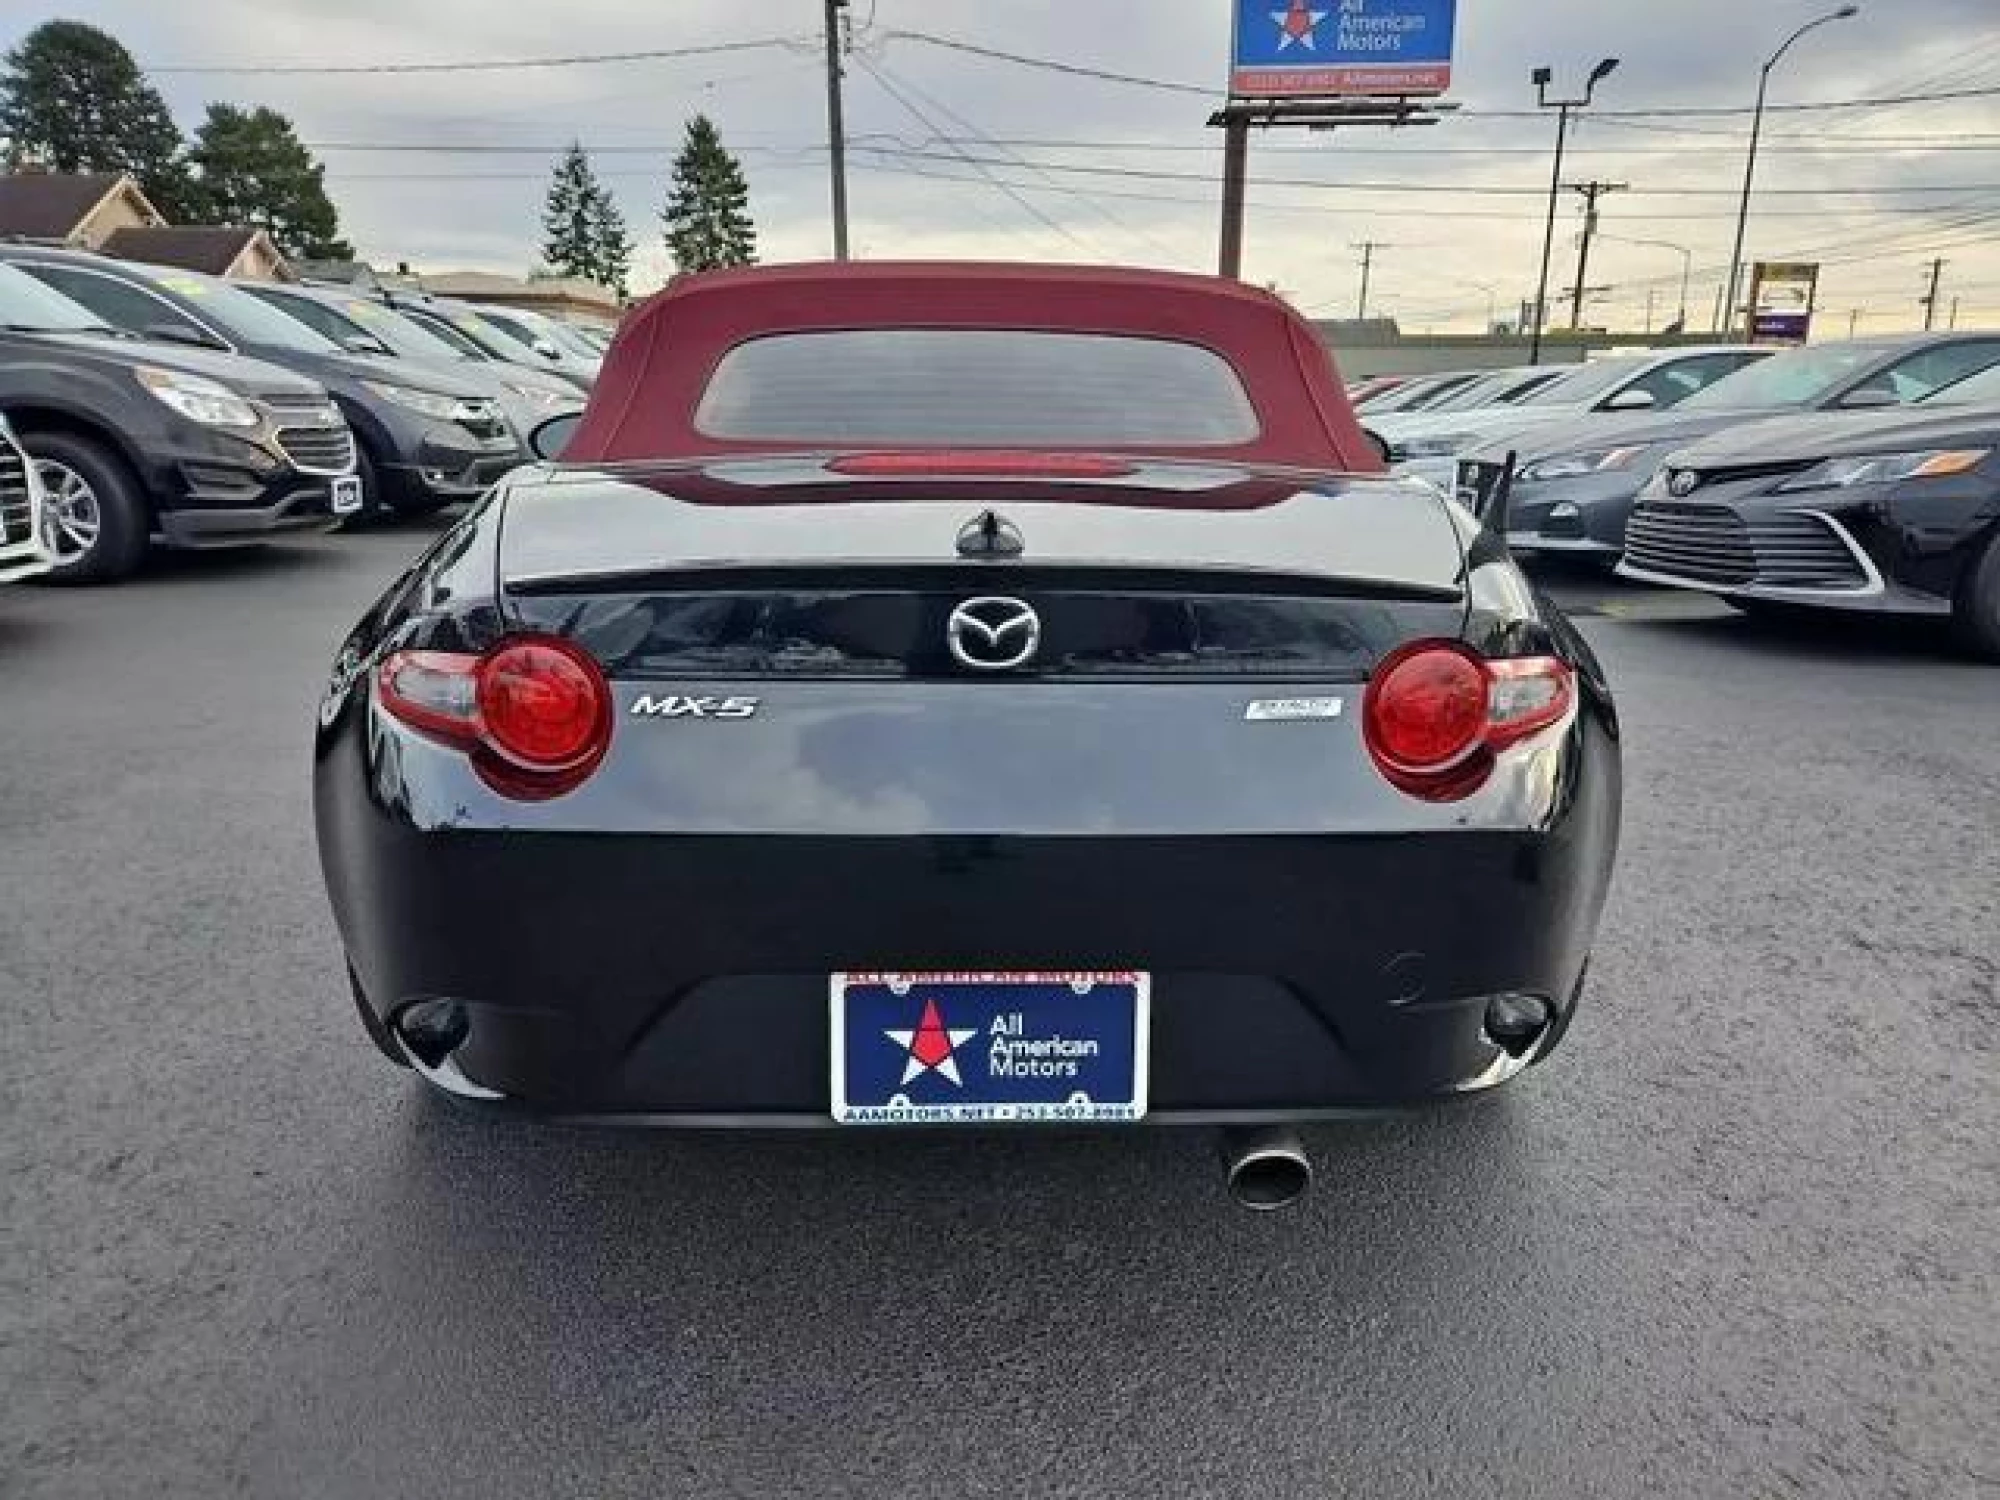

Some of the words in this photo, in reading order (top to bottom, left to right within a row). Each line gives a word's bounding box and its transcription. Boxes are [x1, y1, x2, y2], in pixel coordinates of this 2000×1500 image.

[1338, 14, 1426, 31] American
[1337, 32, 1401, 51] Motors
[630, 696, 757, 718] MX-5
[990, 1013, 1023, 1035] All
[990, 1034, 1099, 1056] American
[990, 1054, 1077, 1077] Motors
